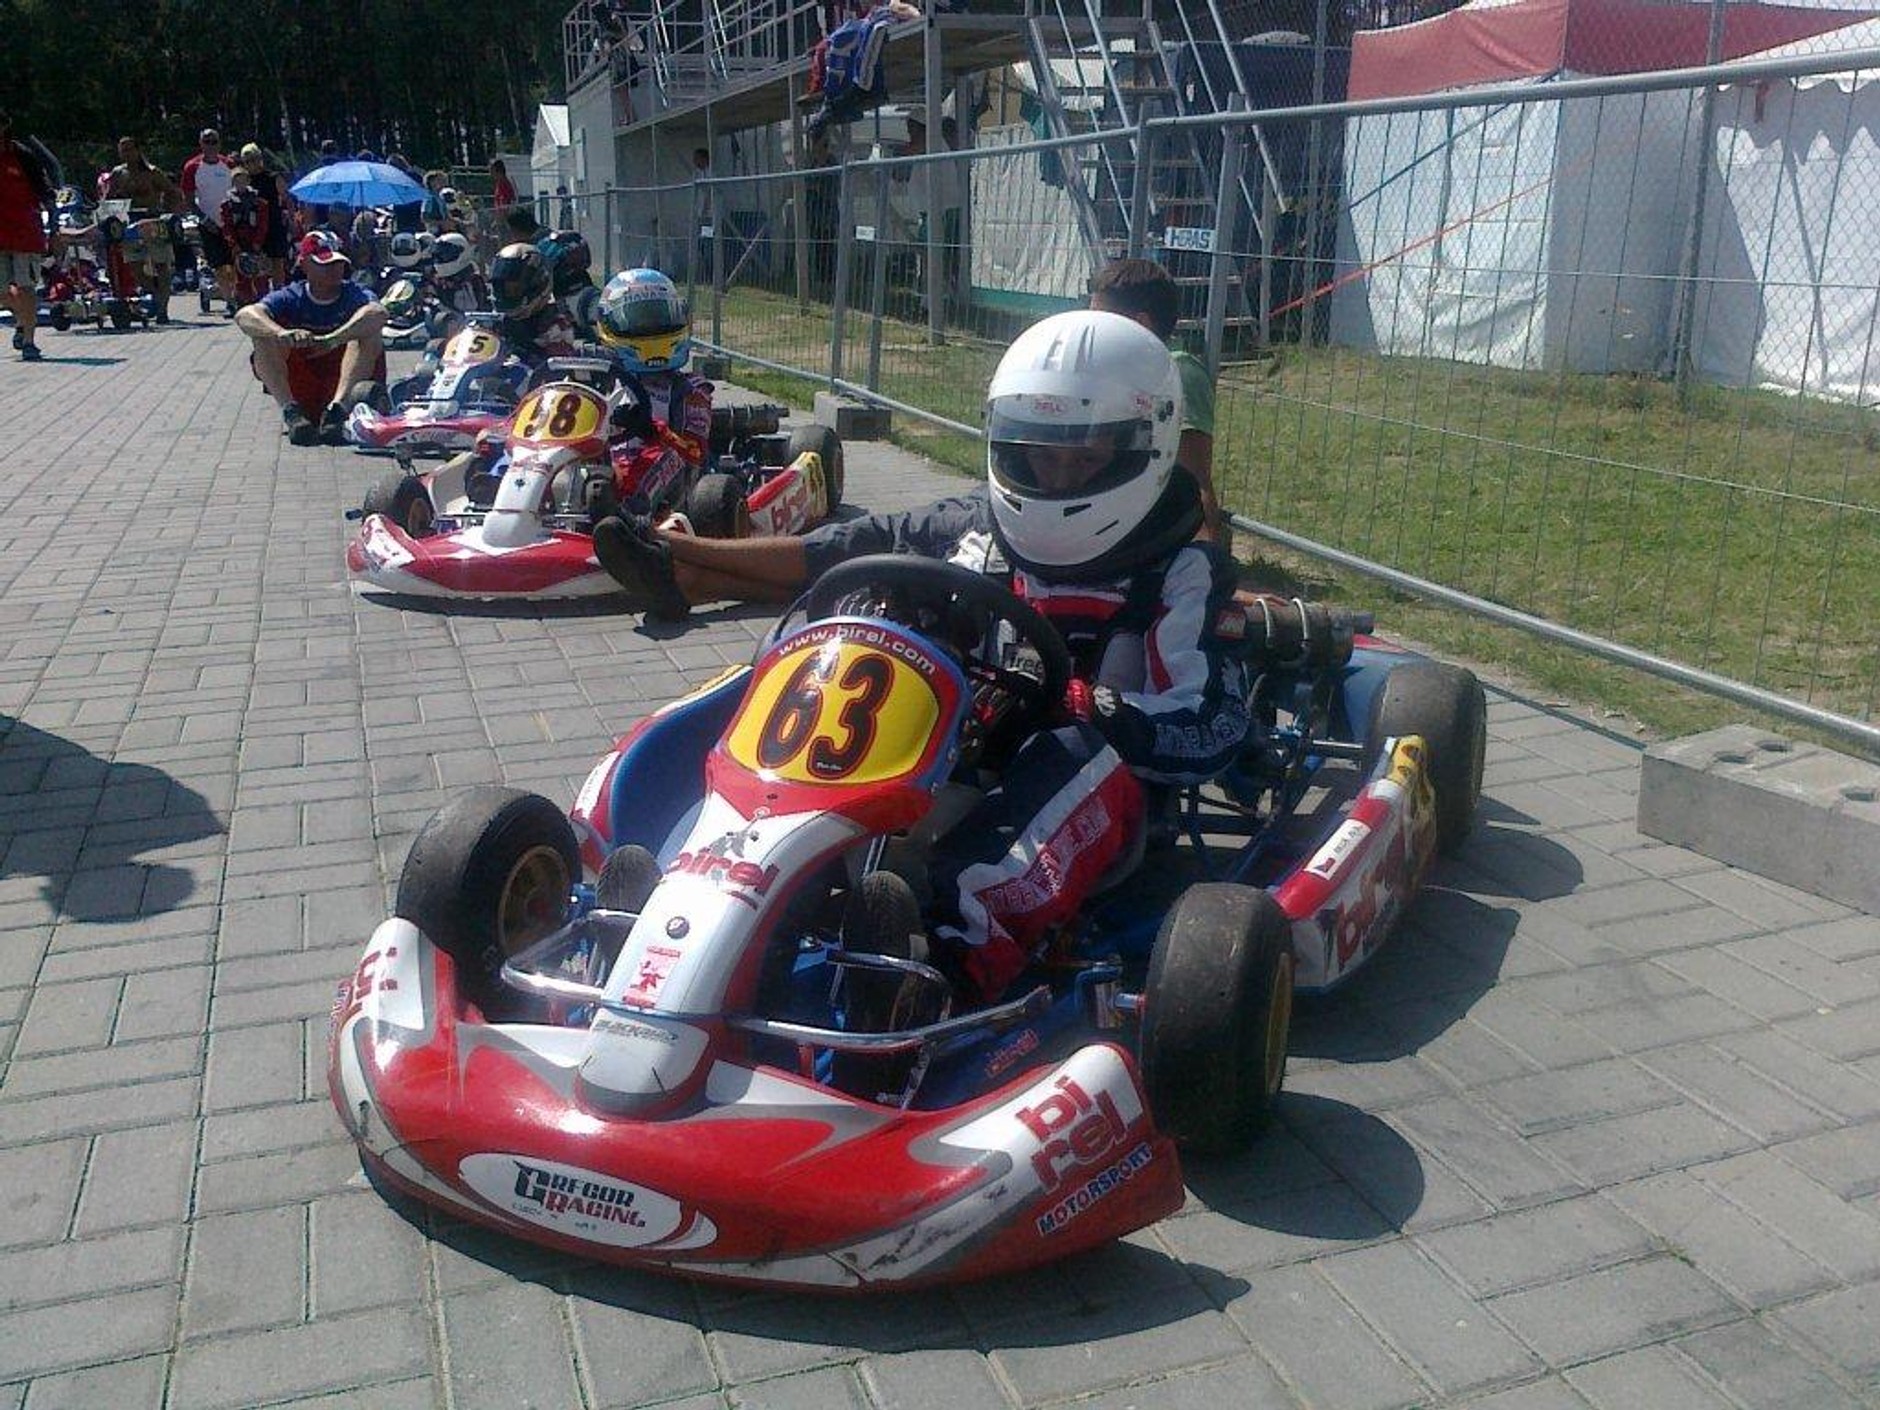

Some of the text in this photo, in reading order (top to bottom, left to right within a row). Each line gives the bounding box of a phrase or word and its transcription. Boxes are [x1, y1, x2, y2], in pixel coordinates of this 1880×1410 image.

[779, 624, 937, 675] www.birel.com
[757, 650, 896, 781] 63
[545, 1191, 646, 1228] RACING
[1036, 1142, 1153, 1236] MOTORSPORT
